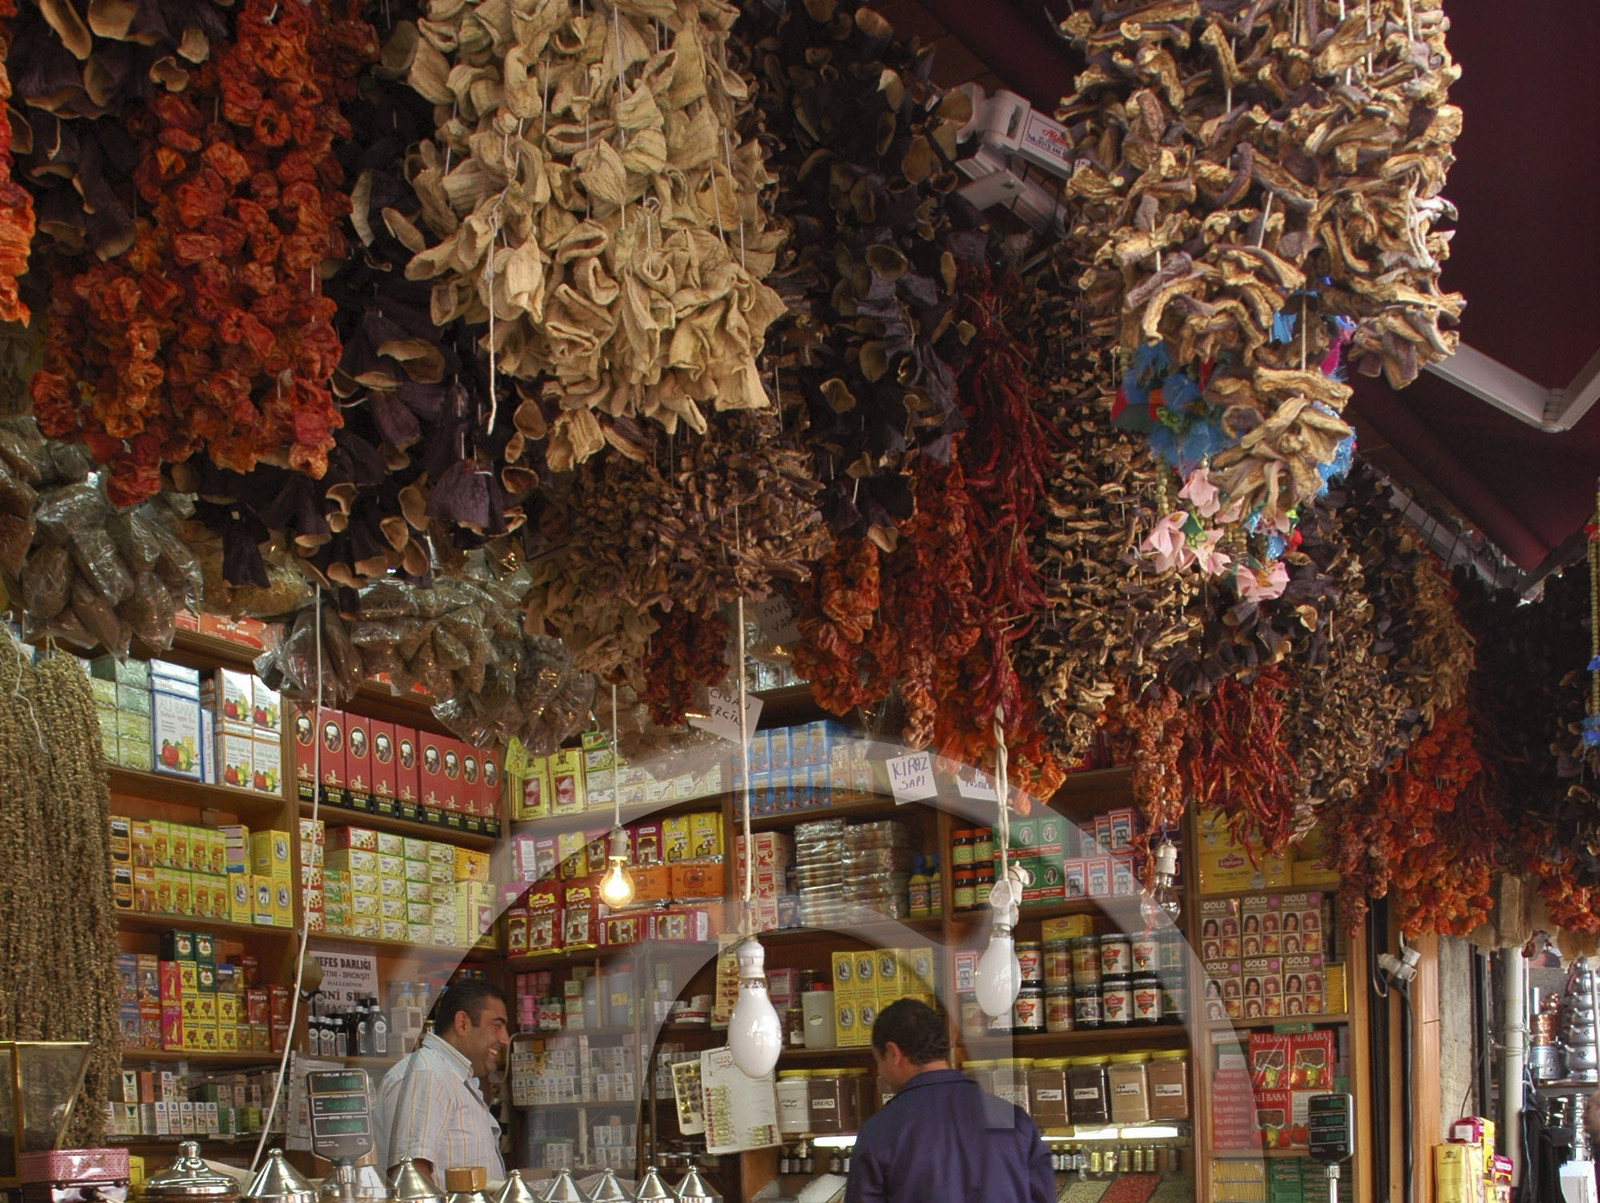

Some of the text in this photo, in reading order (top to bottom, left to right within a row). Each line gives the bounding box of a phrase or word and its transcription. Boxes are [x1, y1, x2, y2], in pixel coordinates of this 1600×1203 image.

[1245, 897, 1267, 905] GOLD
[1284, 894, 1307, 902] GOLD
[1204, 902, 1226, 910] GOLD
[1245, 959, 1268, 967] GOLD
[1287, 956, 1310, 964] GOLD
[1206, 962, 1228, 970] GOLD
[1267, 1093, 1287, 1101] BABA
